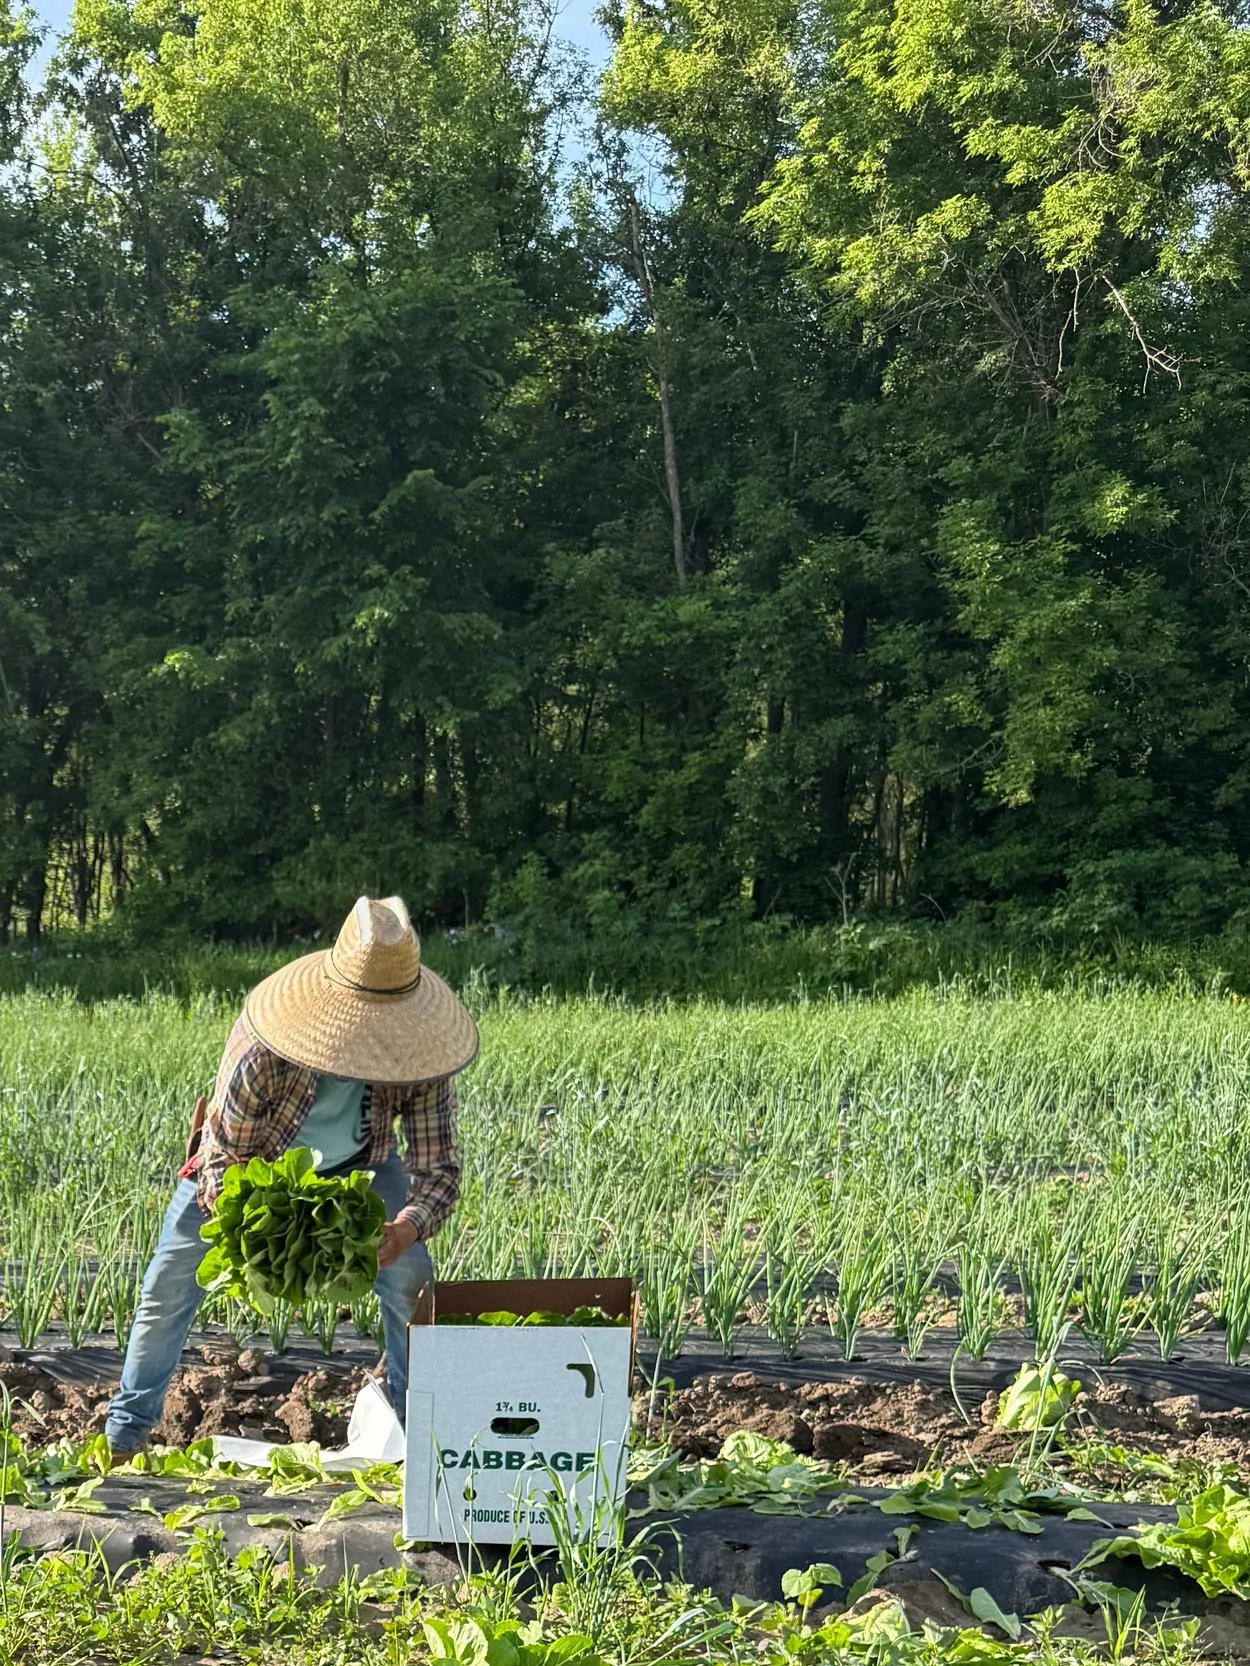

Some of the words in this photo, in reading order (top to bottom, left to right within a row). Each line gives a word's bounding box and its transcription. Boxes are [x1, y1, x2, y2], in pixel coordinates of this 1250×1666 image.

[519, 1402, 541, 1413] BU.
[440, 1449, 597, 1472] CABBAGE
[464, 1509, 509, 1523] PRODUCE
